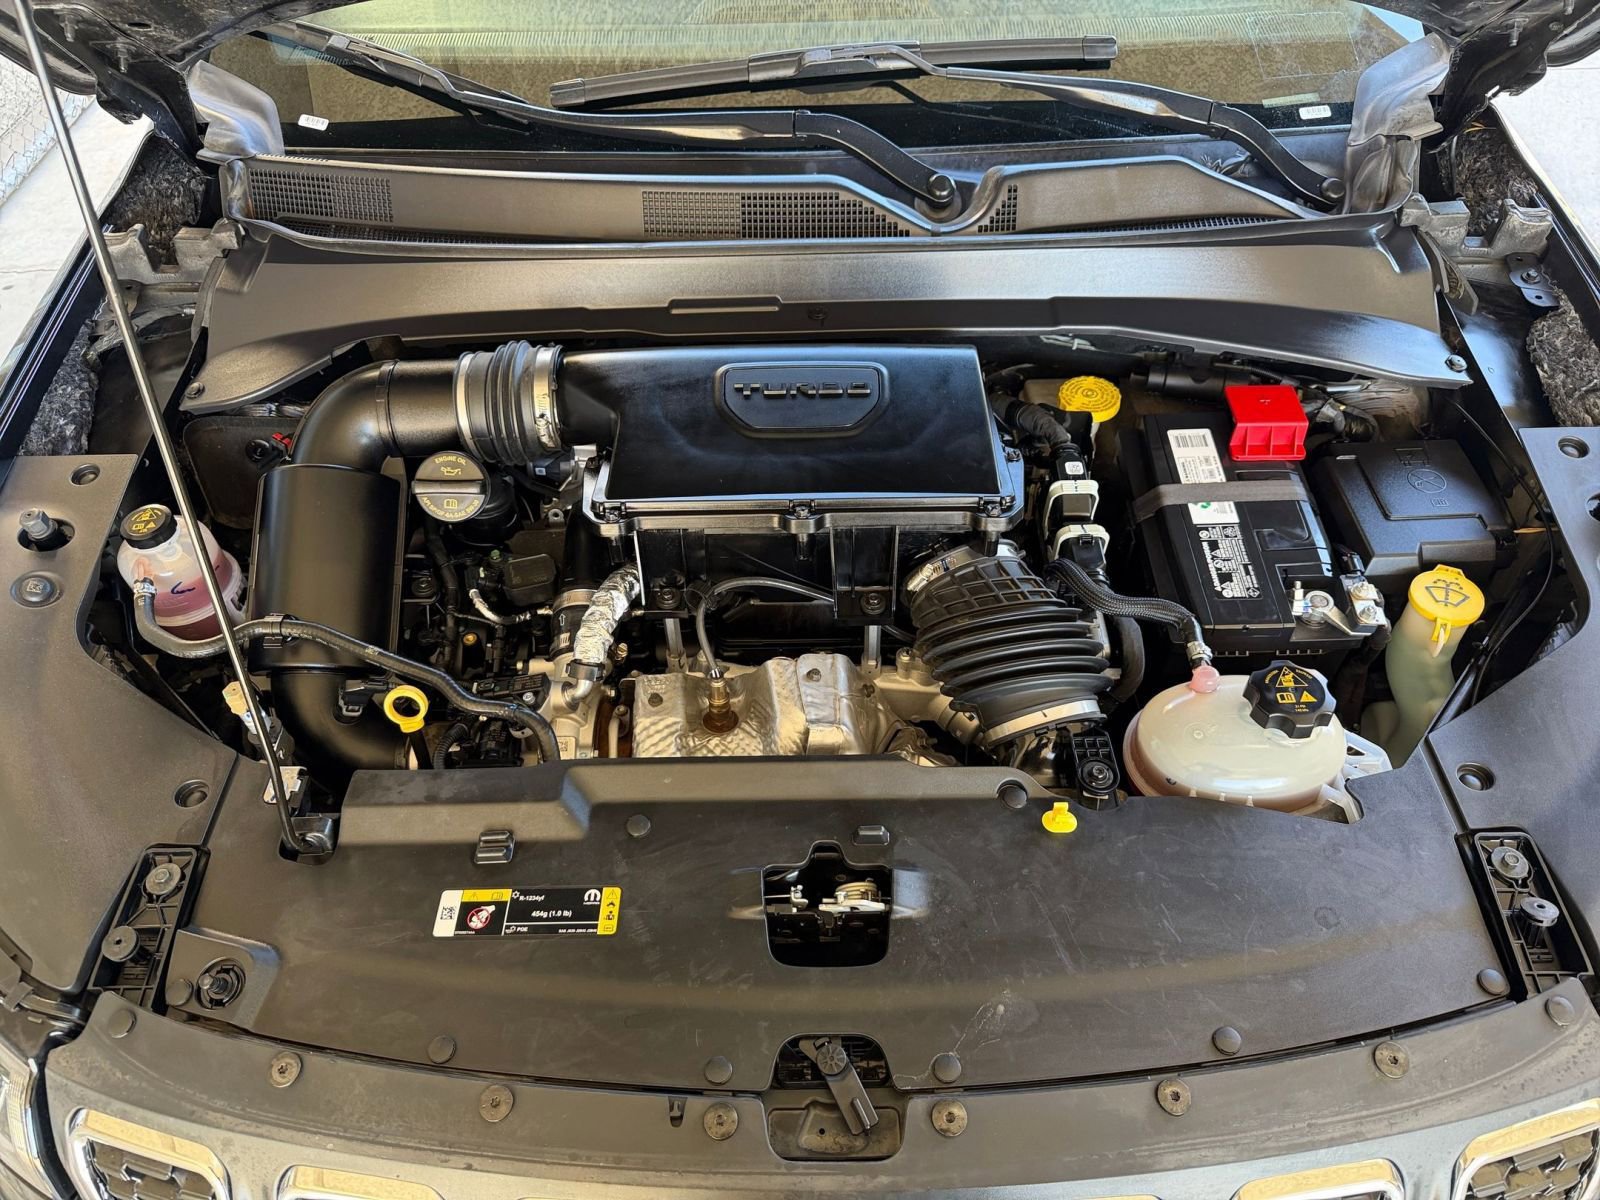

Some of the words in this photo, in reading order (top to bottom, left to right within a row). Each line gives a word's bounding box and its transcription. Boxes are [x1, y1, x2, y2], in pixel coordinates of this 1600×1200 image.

[733, 383, 872, 398] TURBO
[435, 456, 457, 464] ENGINE
[531, 910, 549, 918] 454g
[549, 910, 562, 918] (1.0
[562, 910, 573, 918] lb)
